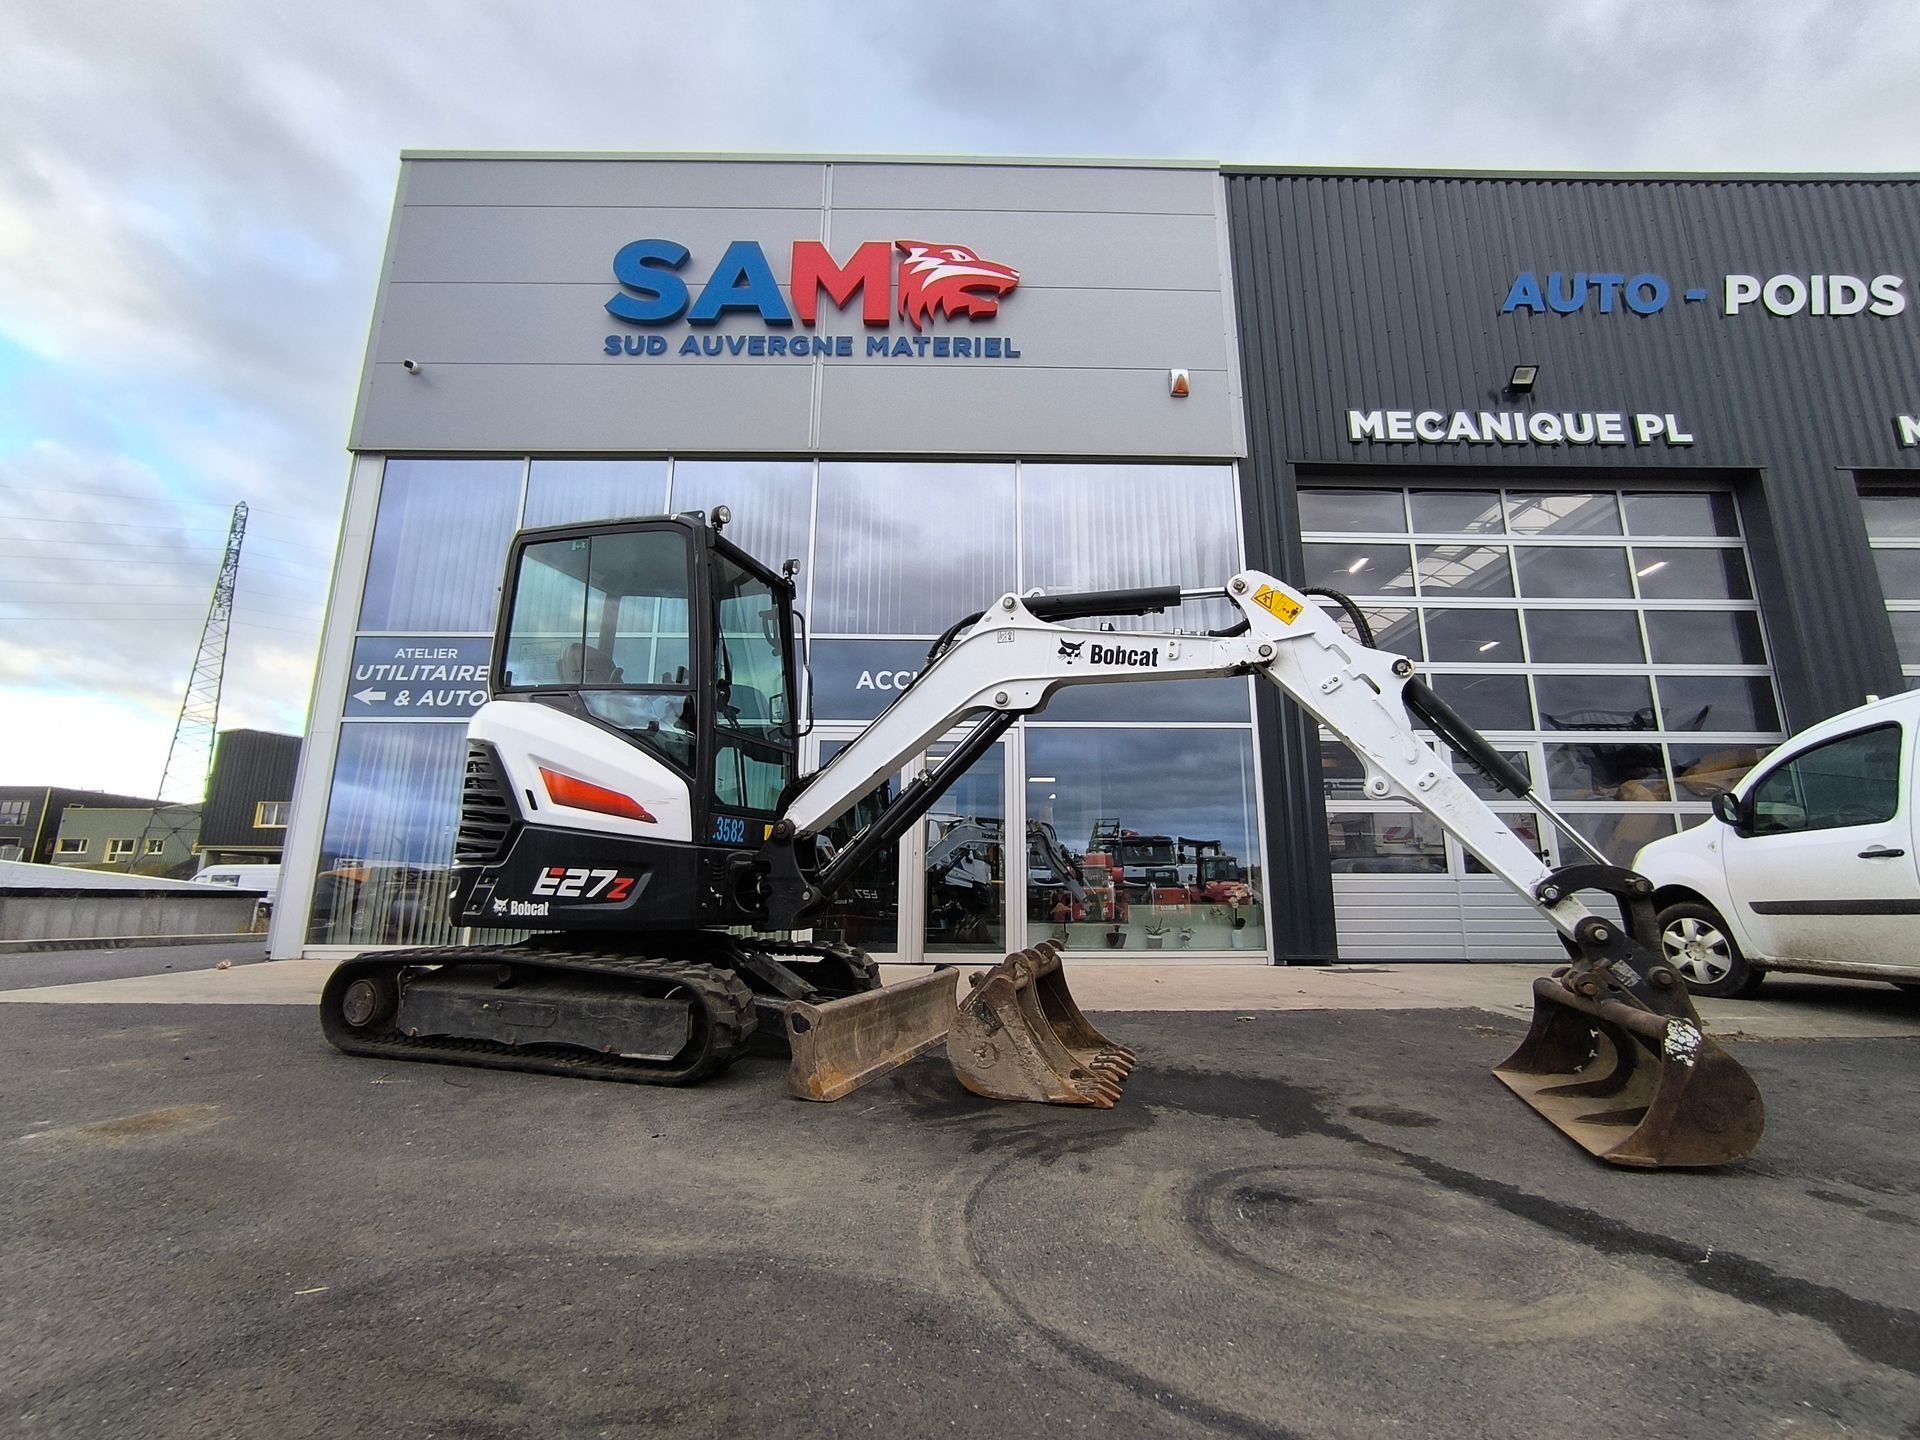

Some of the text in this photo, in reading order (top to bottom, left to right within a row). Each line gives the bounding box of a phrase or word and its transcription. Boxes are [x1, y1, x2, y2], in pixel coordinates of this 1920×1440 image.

[604, 238, 893, 327] SAM
[1501, 271, 1669, 315] AUTO
[1724, 274, 1906, 316] POIDS
[605, 335, 1021, 359] SUD AUVERGNE MATERIEL
[1347, 410, 1694, 444] MECANIQUE PL
[394, 648, 459, 659] ATELIER
[1089, 644, 1159, 668] Bobcat
[393, 690, 411, 706] &
[510, 900, 549, 916] Bobcat
